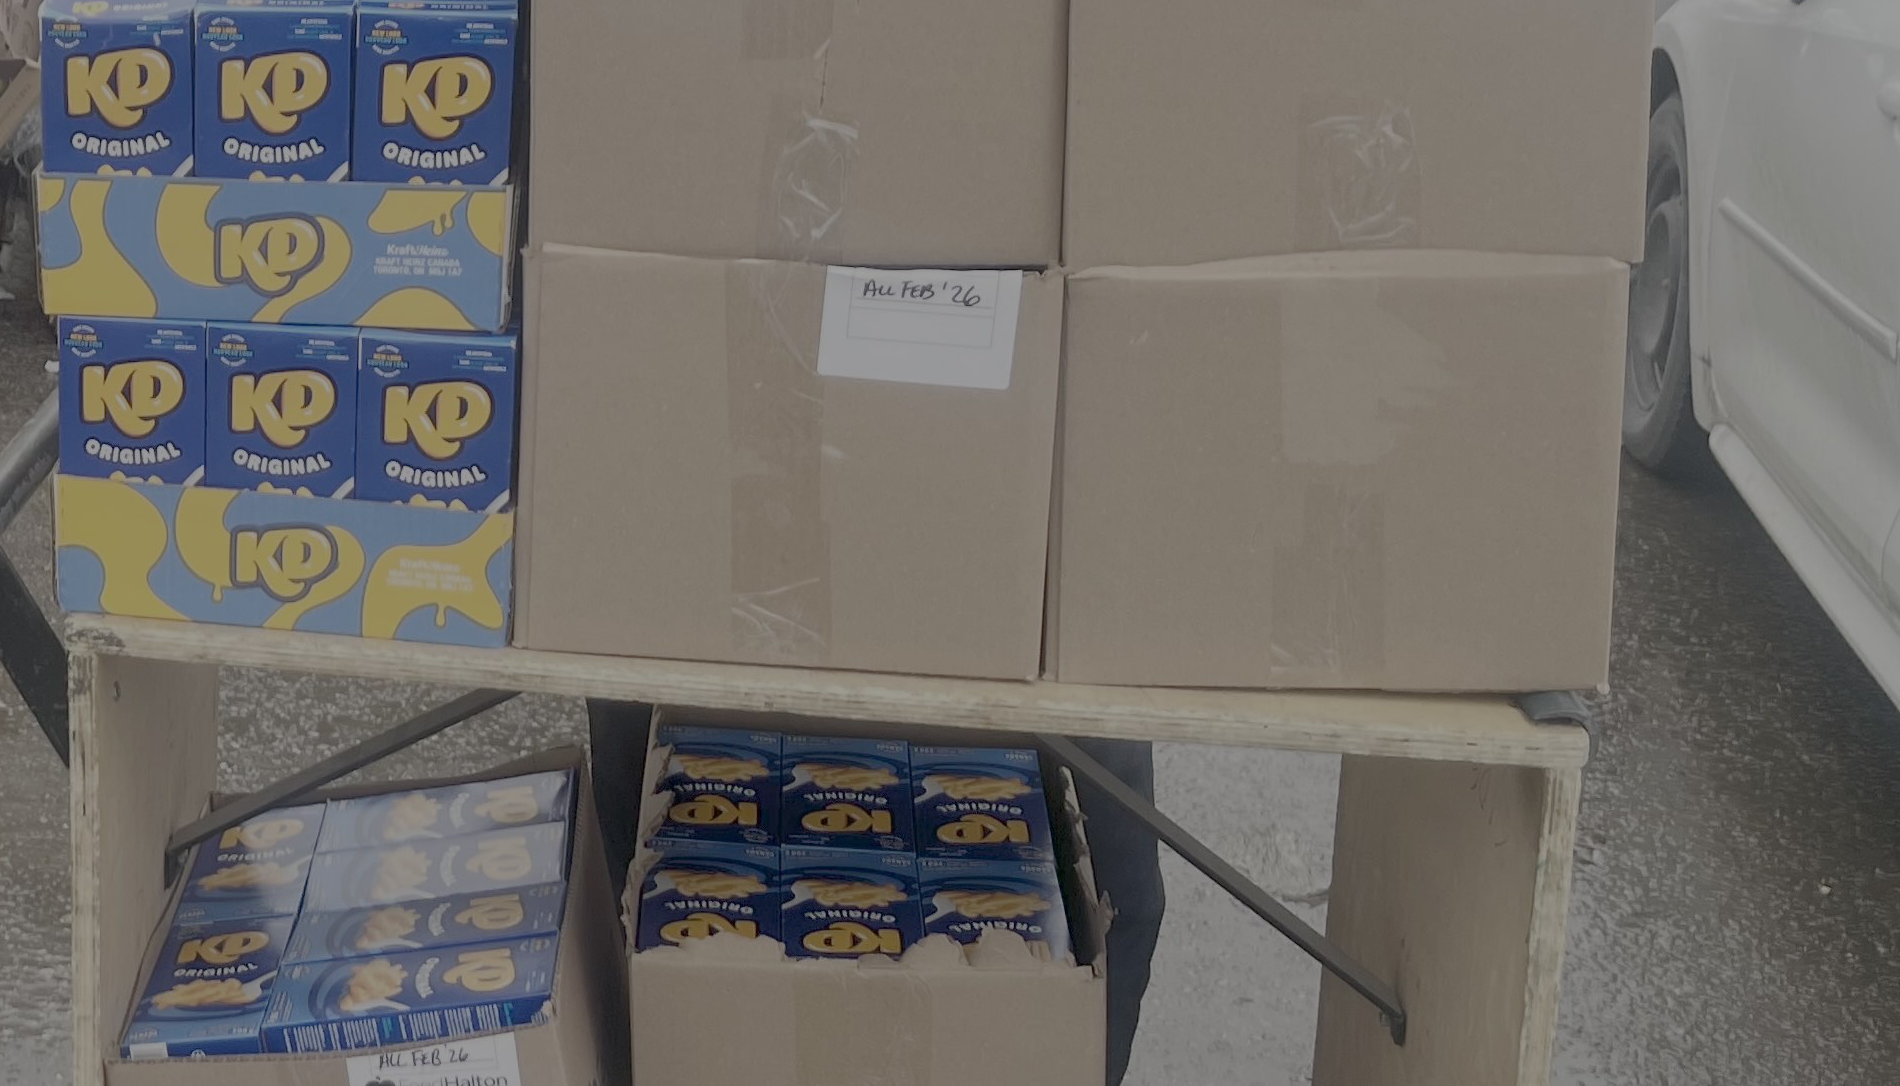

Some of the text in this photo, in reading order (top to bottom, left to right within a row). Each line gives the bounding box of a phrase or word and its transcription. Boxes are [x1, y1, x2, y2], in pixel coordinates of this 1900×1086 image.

[66, 47, 173, 129] KD
[221, 51, 329, 134] KD
[381, 55, 492, 139] KD
[71, 131, 171, 158] ORIGINAL
[223, 137, 325, 164] ORIGINAL
[382, 142, 486, 169] ORIGINAL
[218, 216, 322, 293] KD
[862, 278, 896, 298] ALL
[900, 280, 935, 301] FEB
[82, 360, 185, 438] KD
[231, 369, 336, 448] KD
[383, 380, 492, 460] KD
[84, 438, 182, 466] ORIGINAL
[232, 448, 333, 476] ORIGINAL
[384, 460, 489, 489] ORIGINAL
[235, 530, 335, 599] KD
[473, 785, 539, 824] KD
[673, 782, 756, 797] ORIGINAL
[803, 791, 888, 806] ORIGINAL
[669, 794, 758, 826] KD
[801, 803, 892, 834] KD
[935, 802, 1023, 816] ORIGINAL
[218, 817, 304, 850] KD
[936, 813, 1031, 844] KD
[216, 847, 294, 862] ORIGINAL
[465, 835, 532, 881] KD
[454, 893, 524, 930] KD
[664, 900, 754, 915] ORIGINAL
[804, 909, 896, 924] ORIGINAL
[660, 912, 758, 944] KD
[803, 921, 902, 954] KD
[177, 930, 270, 965] KD
[173, 962, 259, 978] ORIGINAL
[442, 947, 515, 992] KD
